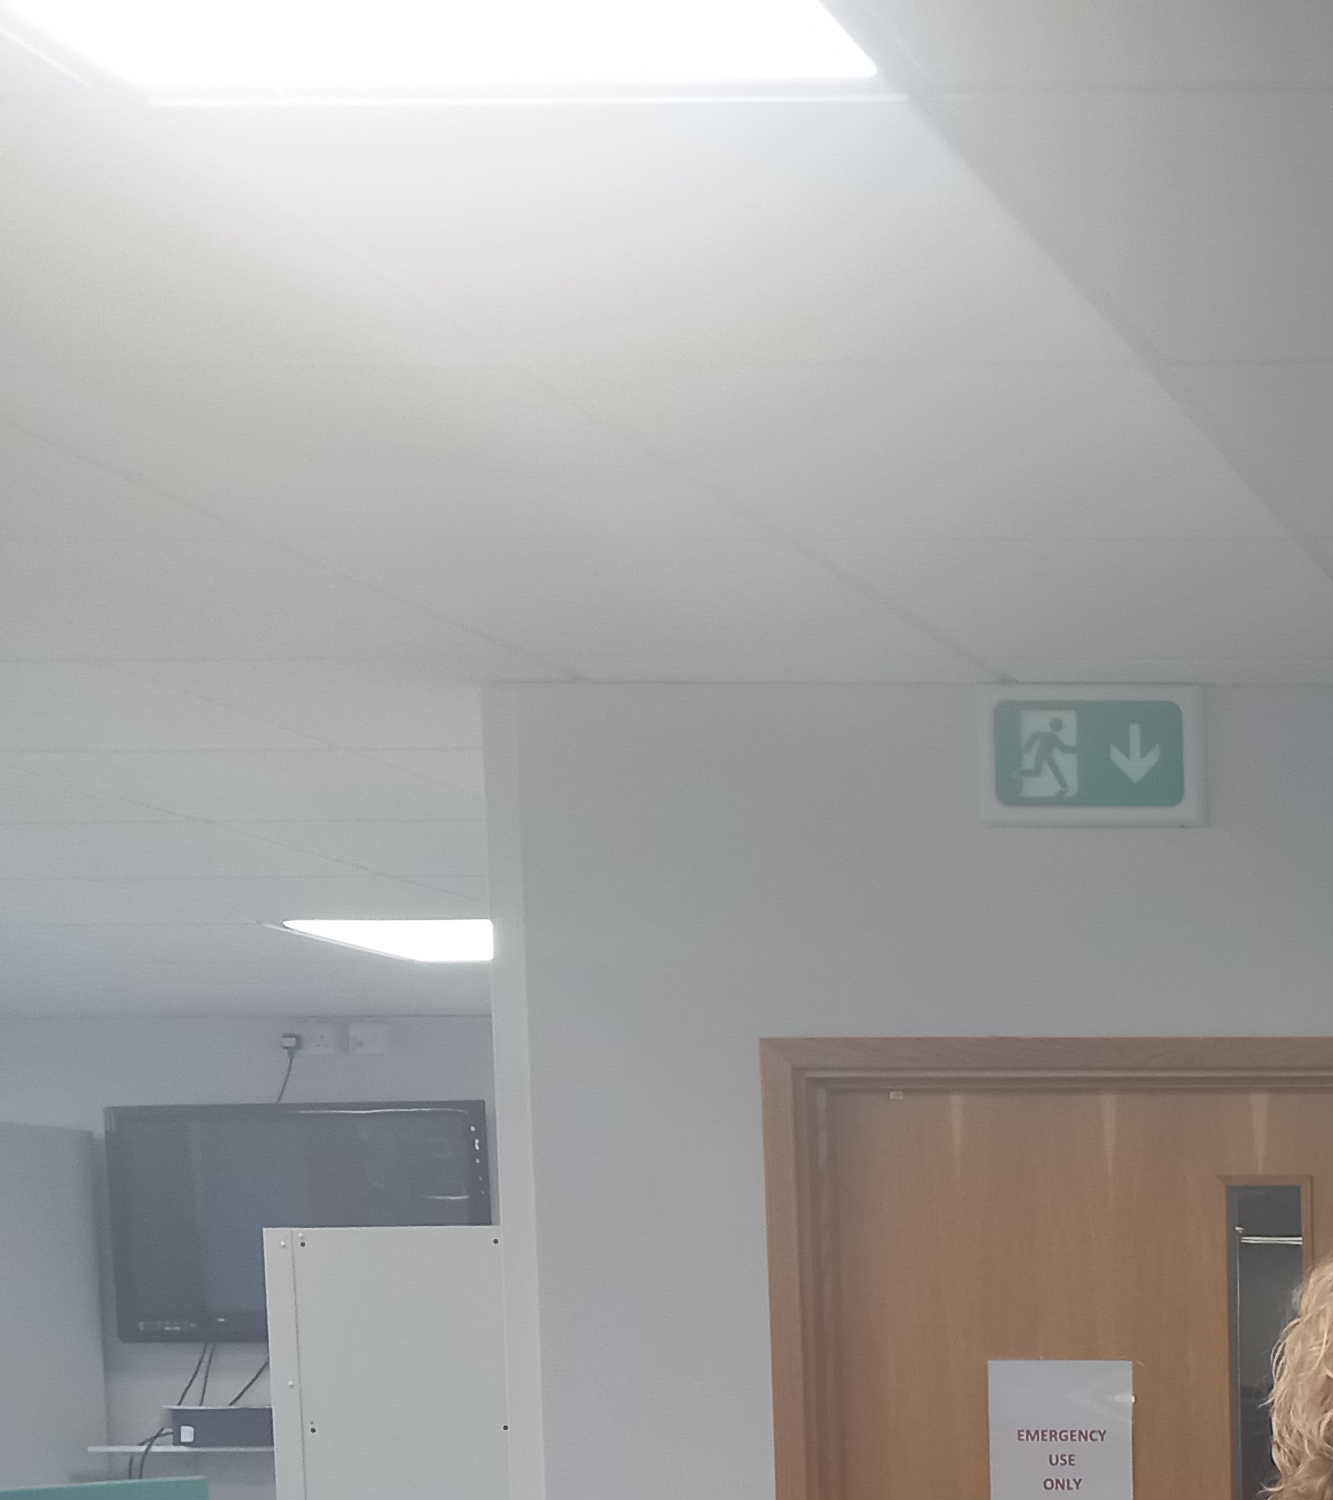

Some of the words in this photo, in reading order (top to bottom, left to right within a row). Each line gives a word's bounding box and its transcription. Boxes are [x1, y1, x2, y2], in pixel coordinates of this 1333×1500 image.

[1017, 1429, 1107, 1442] EMERGENCY
[1048, 1453, 1076, 1467] USE
[1043, 1478, 1082, 1491] ONLY
